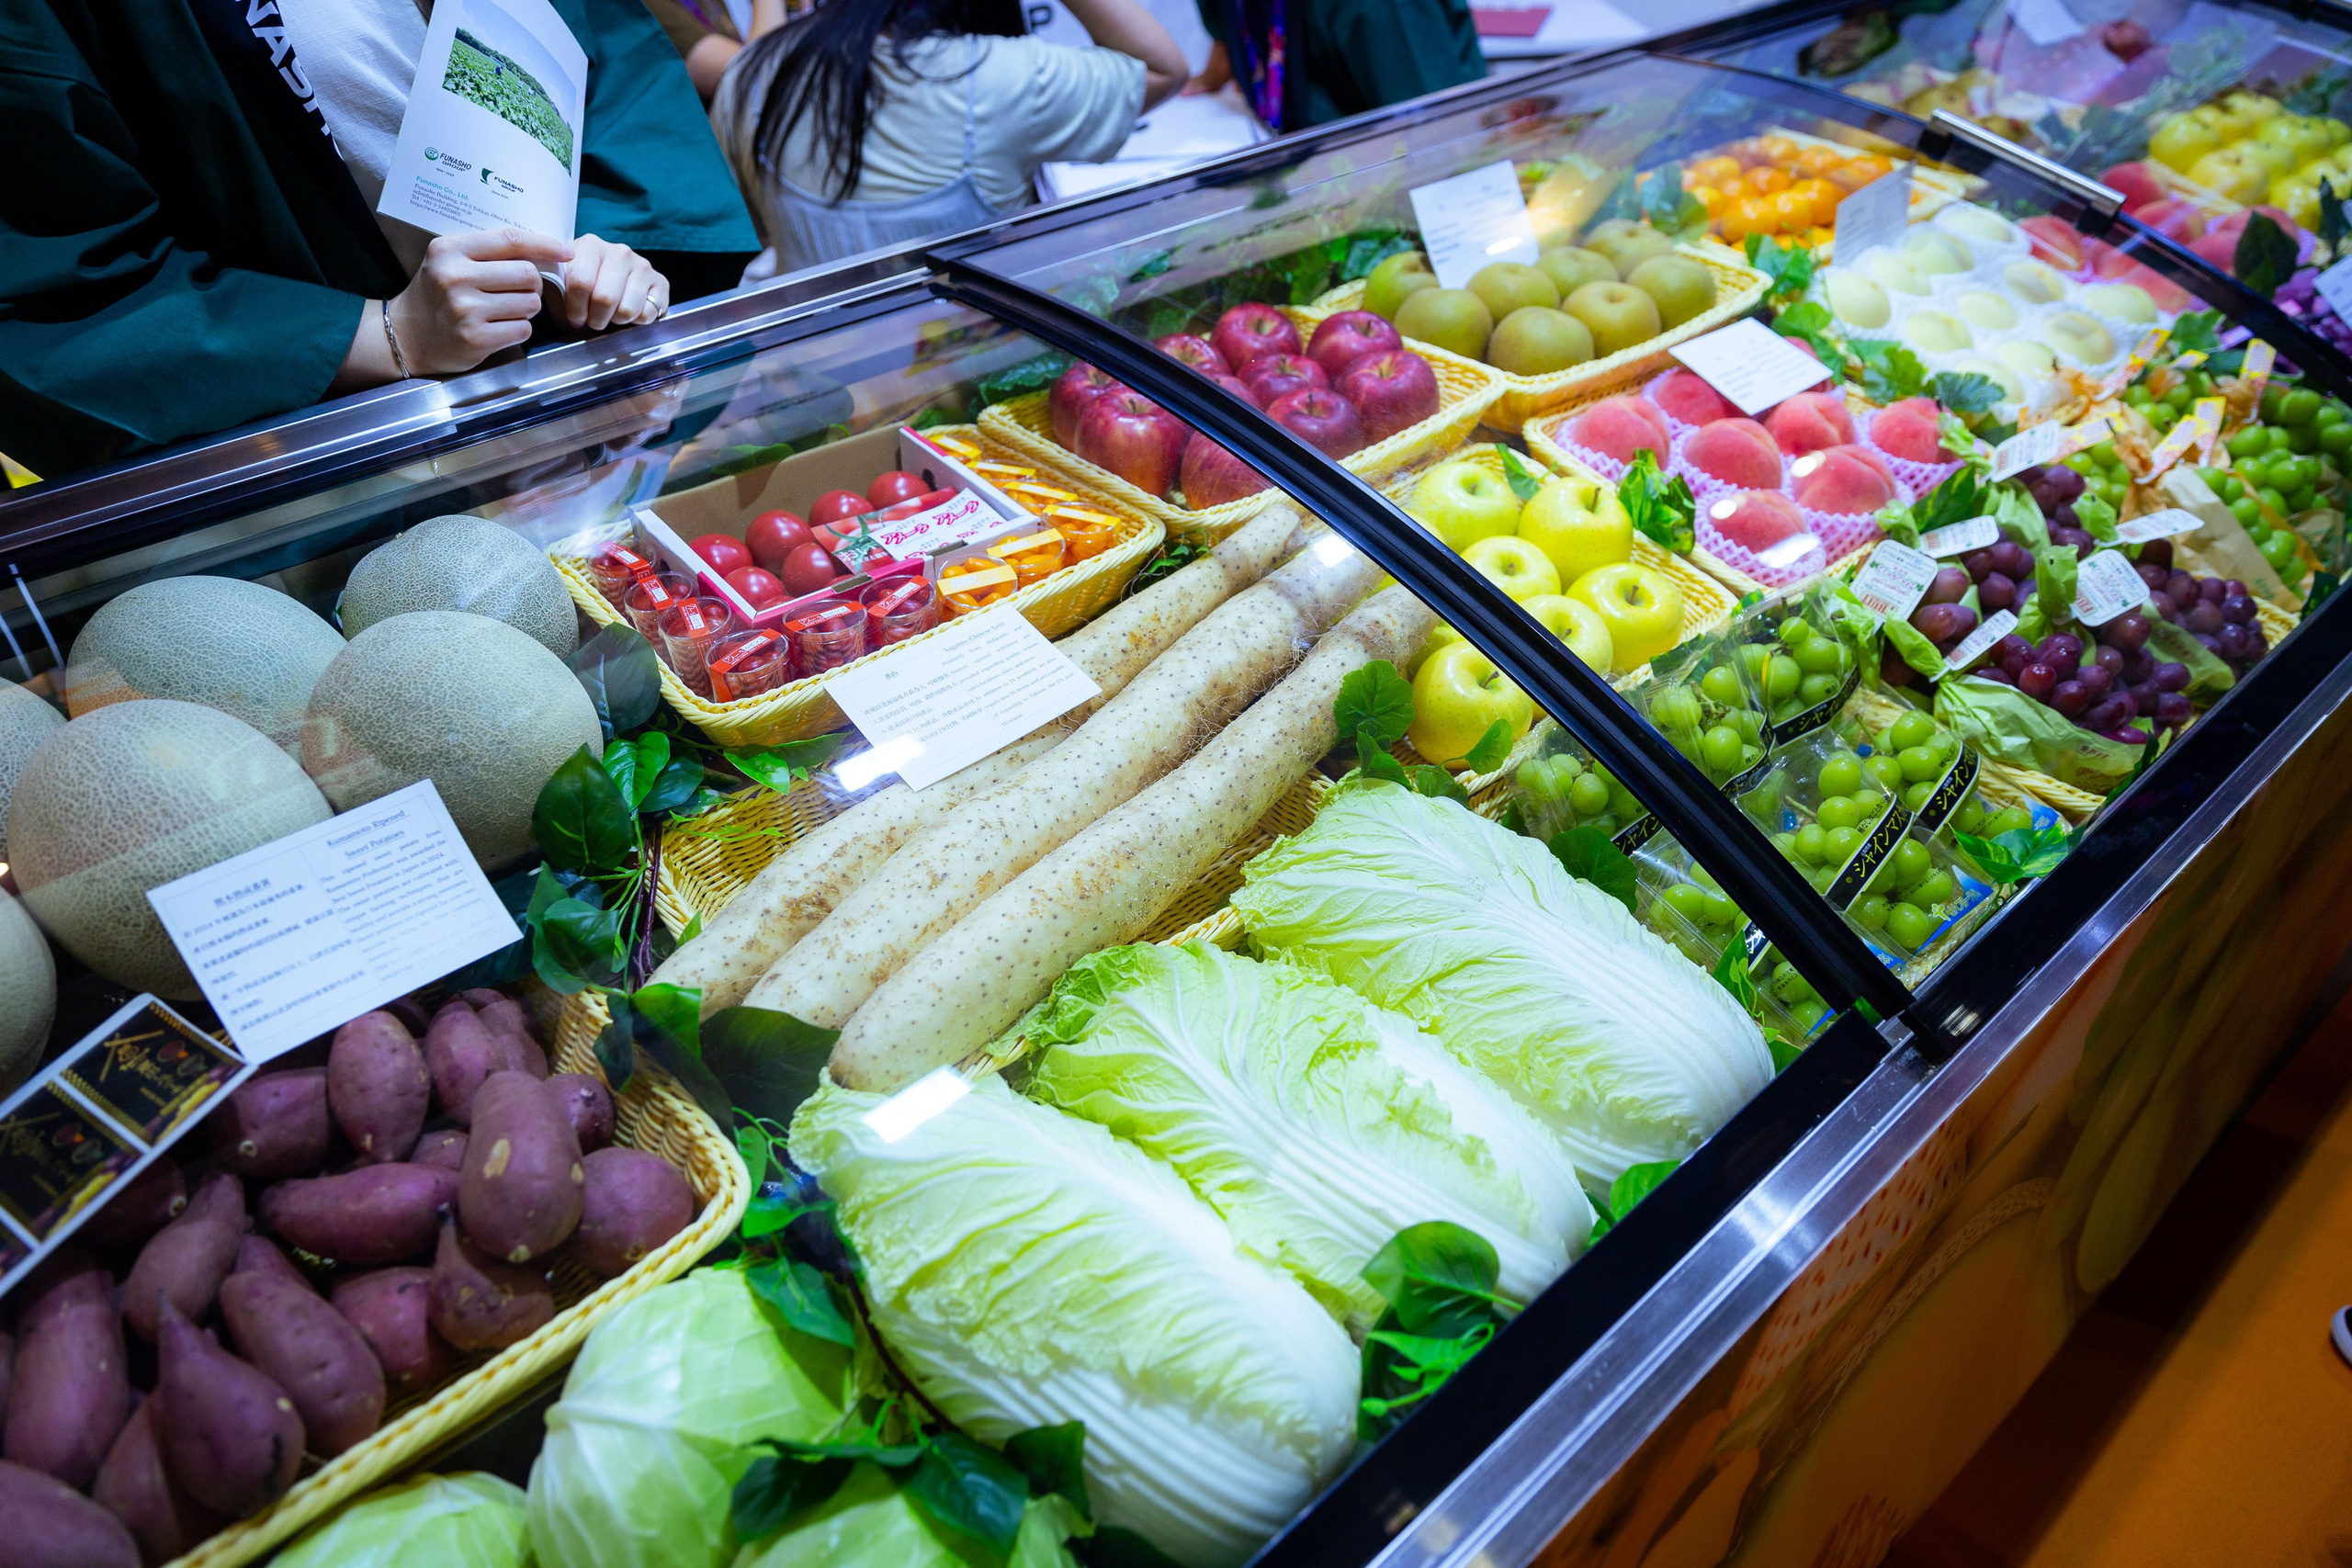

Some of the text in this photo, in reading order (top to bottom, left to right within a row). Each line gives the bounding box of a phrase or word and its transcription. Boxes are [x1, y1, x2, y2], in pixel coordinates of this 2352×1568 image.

[439, 152, 471, 171] FUNASHO
[441, 160, 465, 173] GROUP
[413, 182, 435, 195] Funasho
[415, 175, 469, 201] Funasho Co., Ltd.
[493, 175, 525, 193] FUNASHO
[325, 808, 406, 847] Kumamoto Ripened
[344, 828, 405, 858] Sweet Potatoes
